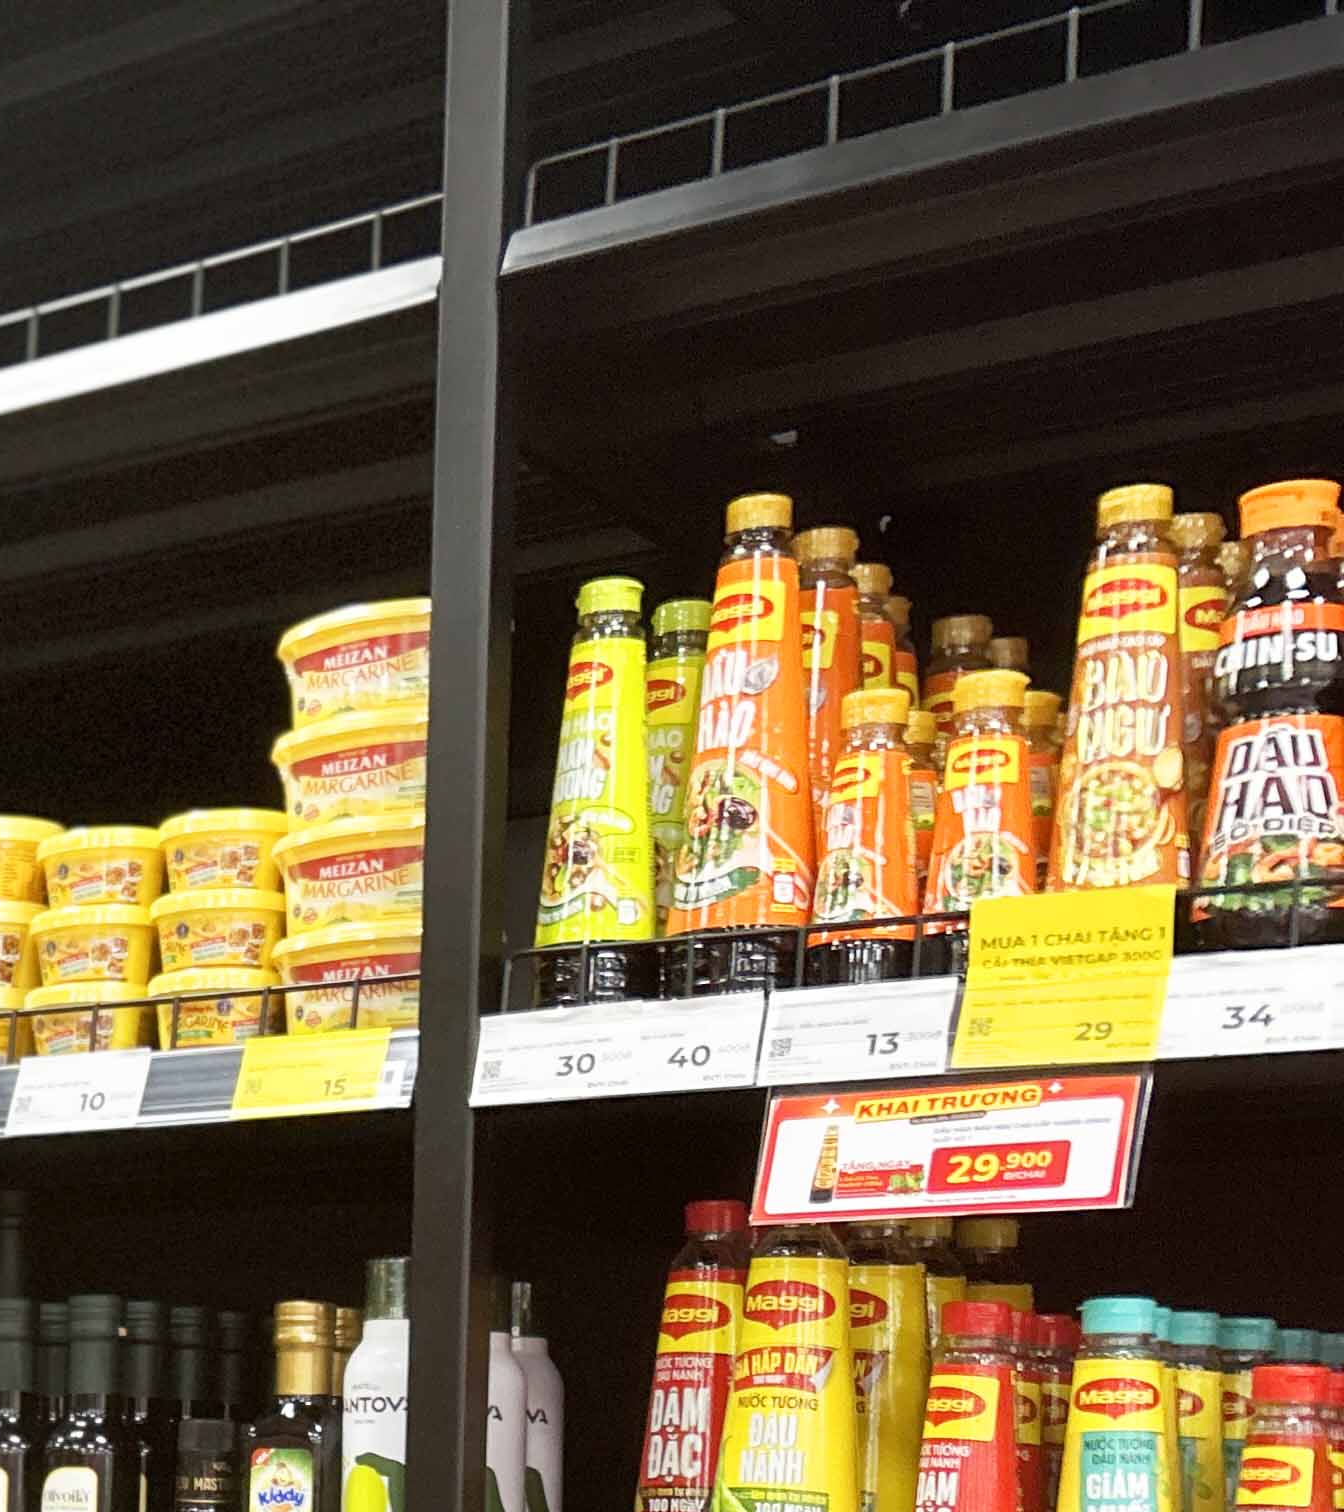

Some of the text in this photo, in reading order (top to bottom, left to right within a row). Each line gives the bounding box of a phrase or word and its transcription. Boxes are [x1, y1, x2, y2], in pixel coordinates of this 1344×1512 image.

[323, 645, 389, 671] MEIZAN
[1214, 630, 1339, 680] CHIN-SU
[306, 651, 413, 691] MARGARINE
[320, 752, 388, 777] MEIZAN
[303, 765, 412, 796] MARGARINE
[318, 857, 384, 880] MEIZAN
[302, 867, 410, 899] MARGARINE
[980, 935, 1025, 951] MUA
[1043, 931, 1092, 948] CHAI
[1098, 926, 1153, 948] TẶNG
[1158, 926, 1167, 941] 1
[1221, 1003, 1275, 1031] 34
[865, 1031, 900, 1057] 13
[1073, 1021, 1114, 1042] 29
[555, 1051, 596, 1078] 30
[666, 1043, 712, 1070] 40
[322, 1077, 346, 1098] 15
[78, 1092, 105, 1112] 10
[857, 1086, 1040, 1120] KHAI TRƯƠNG
[945, 1149, 1055, 1186] 29.900
[746, 1290, 825, 1316] Maggi
[1078, 1387, 1156, 1407] Maggi
[257, 1486, 305, 1509] Kiddy
[648, 1498, 669, 1512] 100
